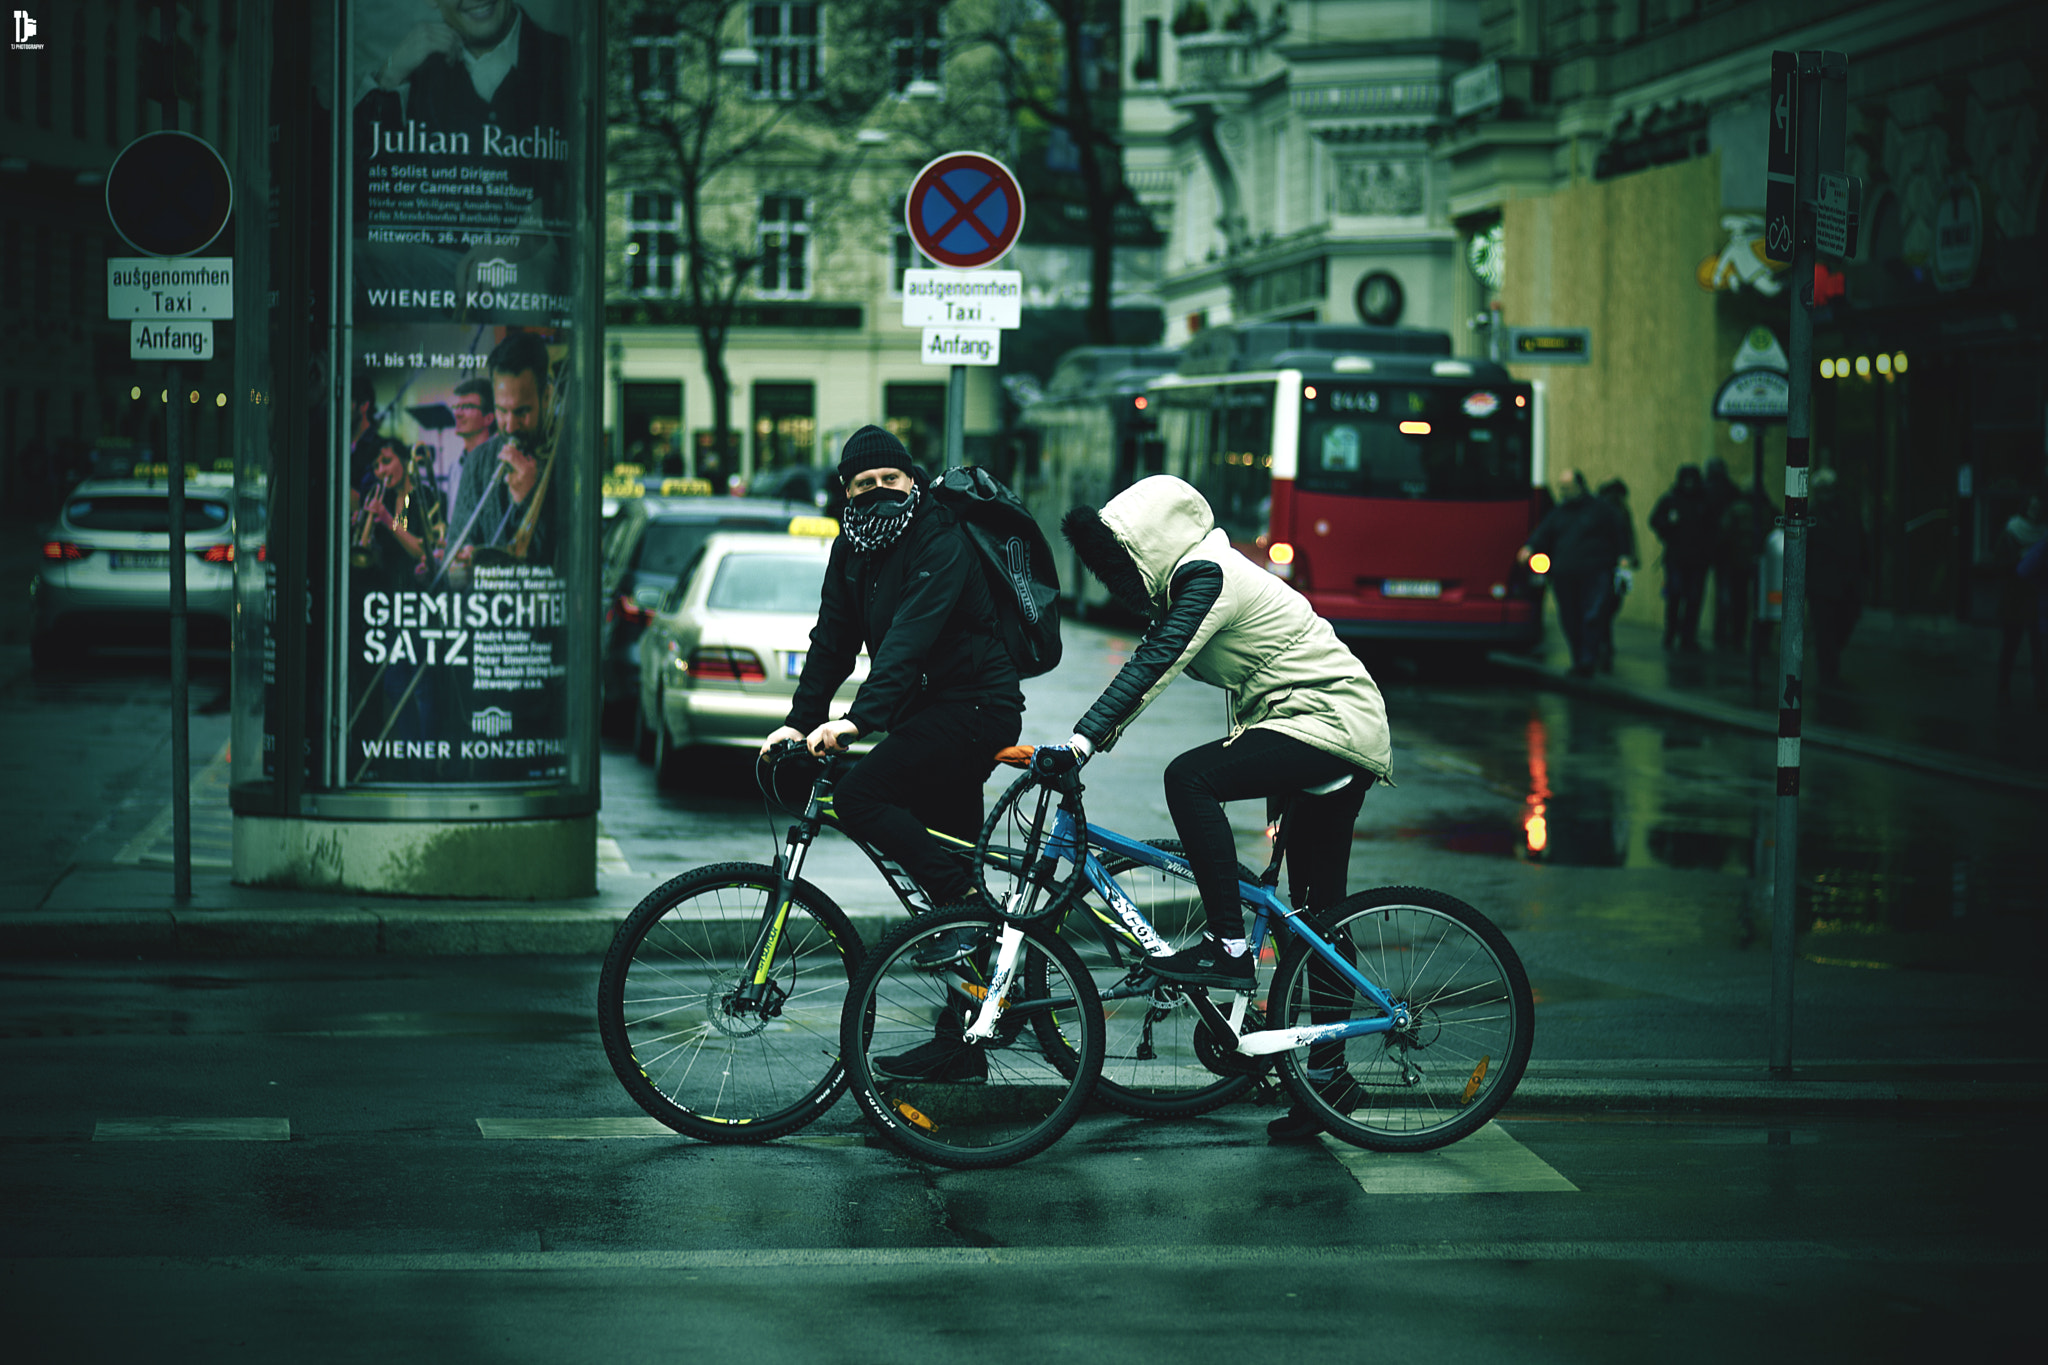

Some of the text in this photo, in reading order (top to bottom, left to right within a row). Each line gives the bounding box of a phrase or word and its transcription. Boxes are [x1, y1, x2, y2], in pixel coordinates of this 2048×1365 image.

[368, 119, 570, 162] Julian Rachlin
[368, 165, 510, 184] als Solist und Dirigent
[368, 181, 535, 201] mit der Camerata Salzburg
[368, 229, 521, 248] Mittwoch, 26. April 2017
[113, 267, 230, 291] ausgenommen
[367, 289, 457, 310] WIENER
[909, 279, 1018, 301] ausgenommen
[152, 291, 193, 313] Taxi
[946, 302, 982, 321] Taxi
[140, 326, 204, 355] Anfang
[931, 334, 991, 361] Anfang
[363, 352, 489, 369] 11. bis 13. Mai 2017
[474, 565, 515, 579] Festival
[516, 565, 531, 578] für
[1016, 576, 1035, 620] ORTLIEB
[363, 629, 470, 666] SATZ
[474, 655, 501, 667] Peter
[474, 667, 492, 679] The
[494, 666, 525, 679] Danish
[361, 738, 451, 760] WIENER
[815, 1087, 831, 1104] SAM
[864, 1089, 897, 1129] KENDA
